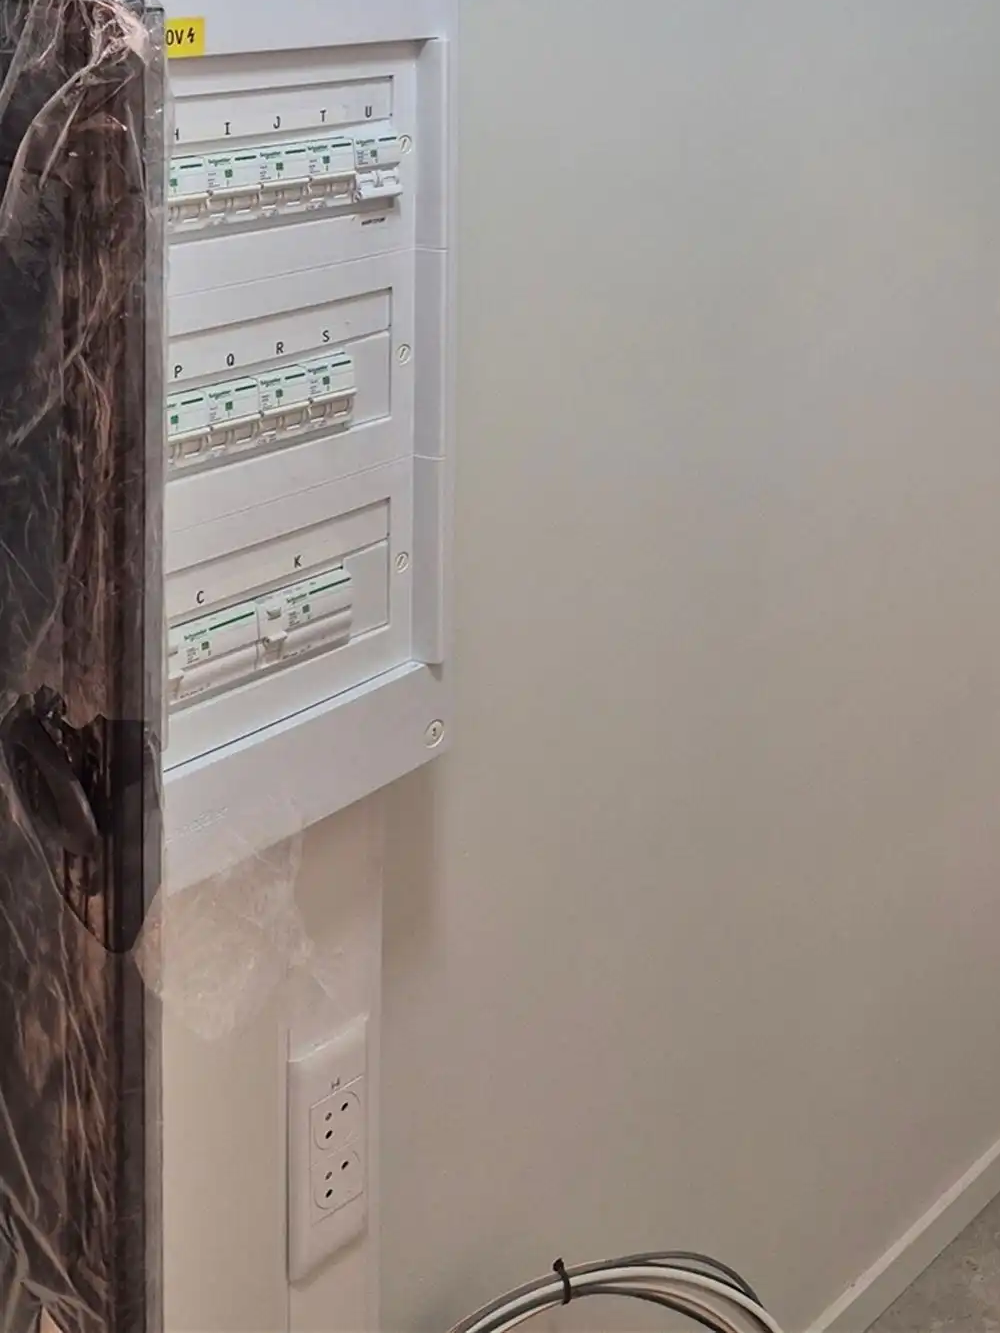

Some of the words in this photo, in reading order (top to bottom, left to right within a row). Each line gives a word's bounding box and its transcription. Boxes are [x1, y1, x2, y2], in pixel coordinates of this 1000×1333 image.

[225, 121, 231, 136] I
[273, 116, 281, 130] J
[320, 109, 327, 122] T
[365, 106, 373, 119] U
[174, 365, 183, 379] P
[275, 341, 285, 355] R
[322, 330, 331, 343] S
[293, 554, 303, 568] K
[196, 590, 205, 604] C
